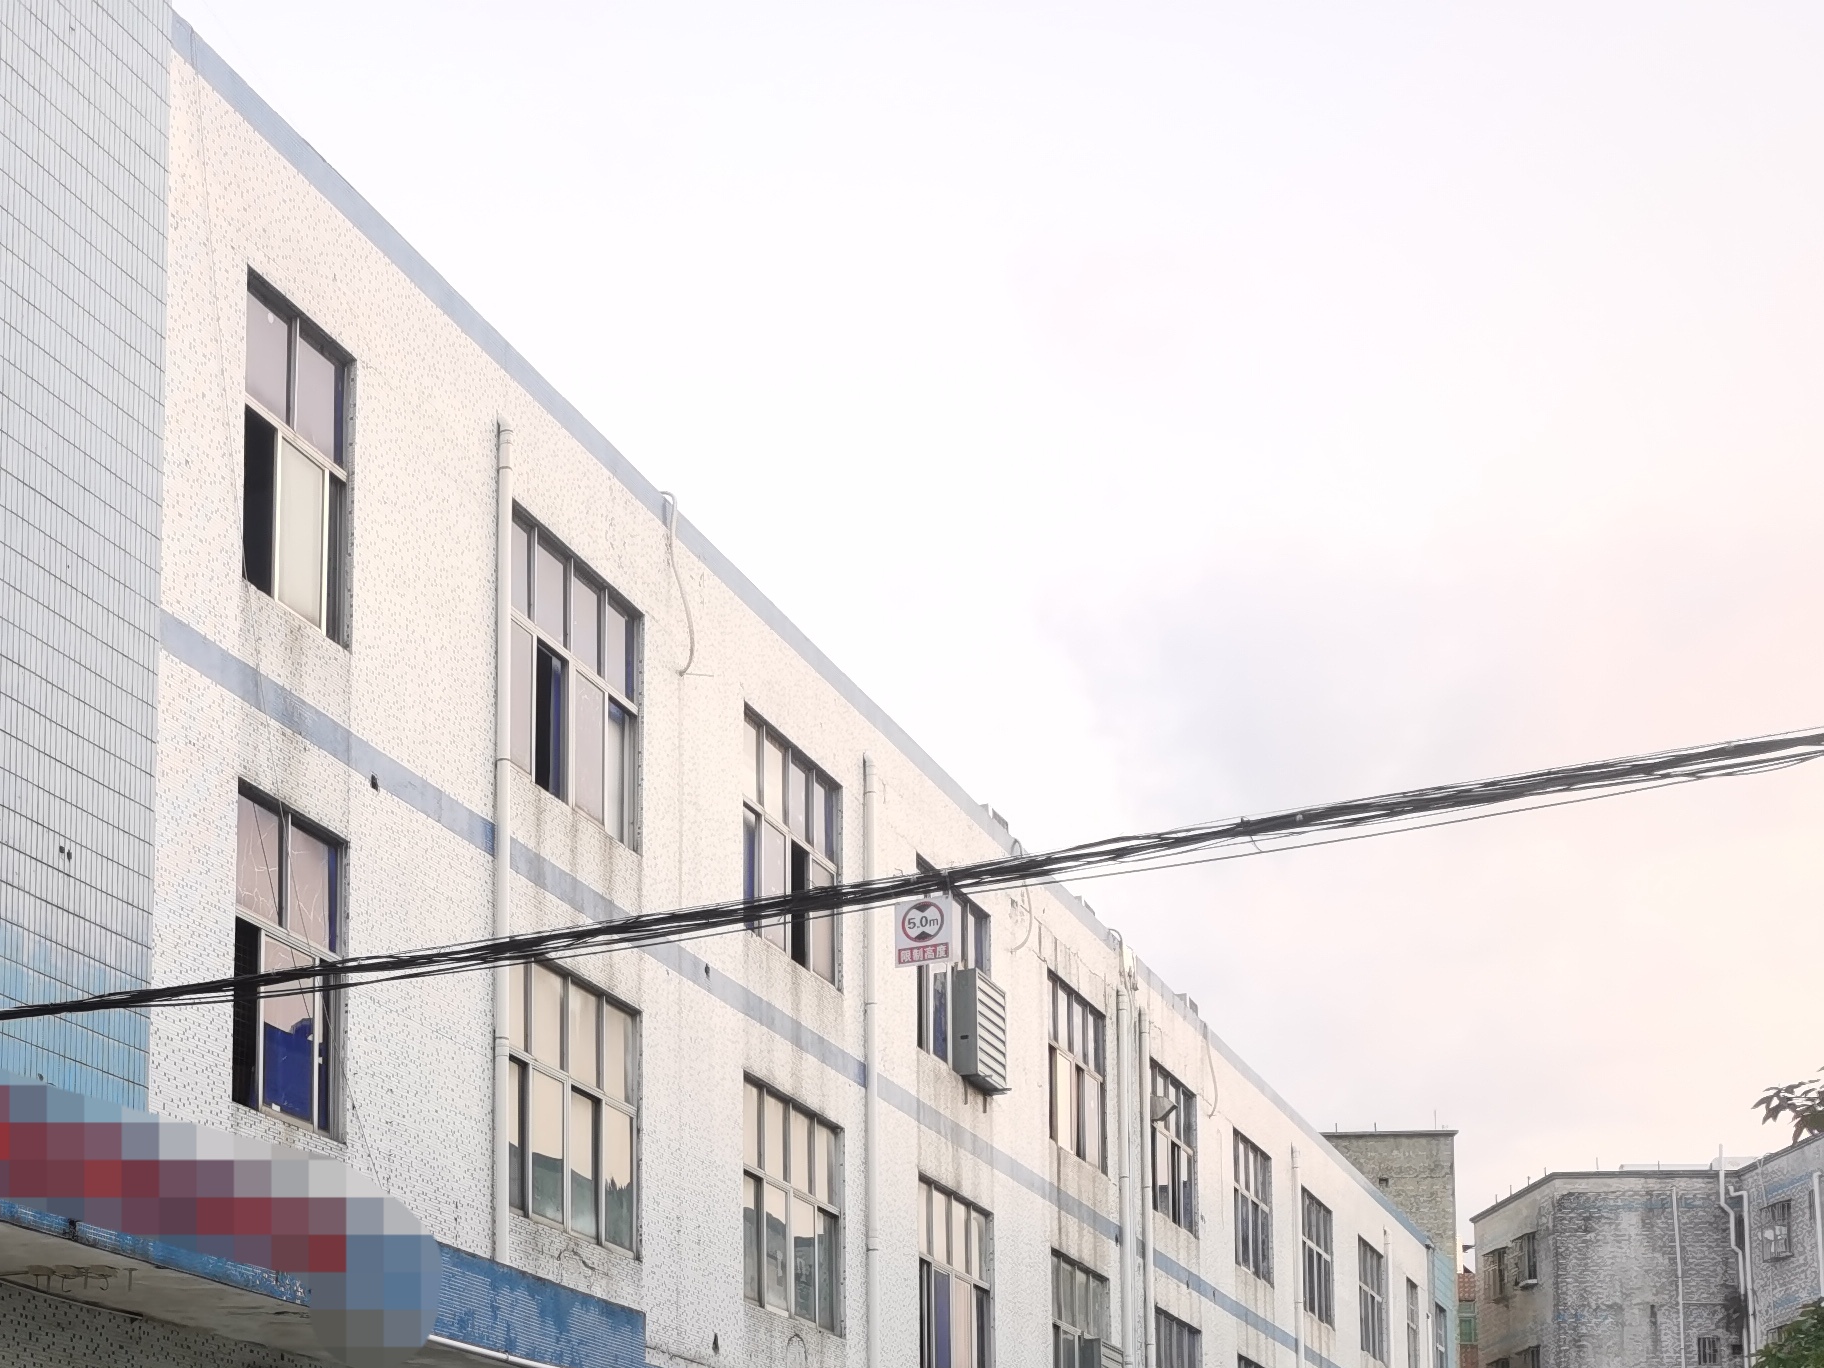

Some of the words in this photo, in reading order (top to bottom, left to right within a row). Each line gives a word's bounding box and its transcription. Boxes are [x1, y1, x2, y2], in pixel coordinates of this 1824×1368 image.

[907, 915, 939, 930] 5.0m
[900, 945, 948, 963] 限制高度
